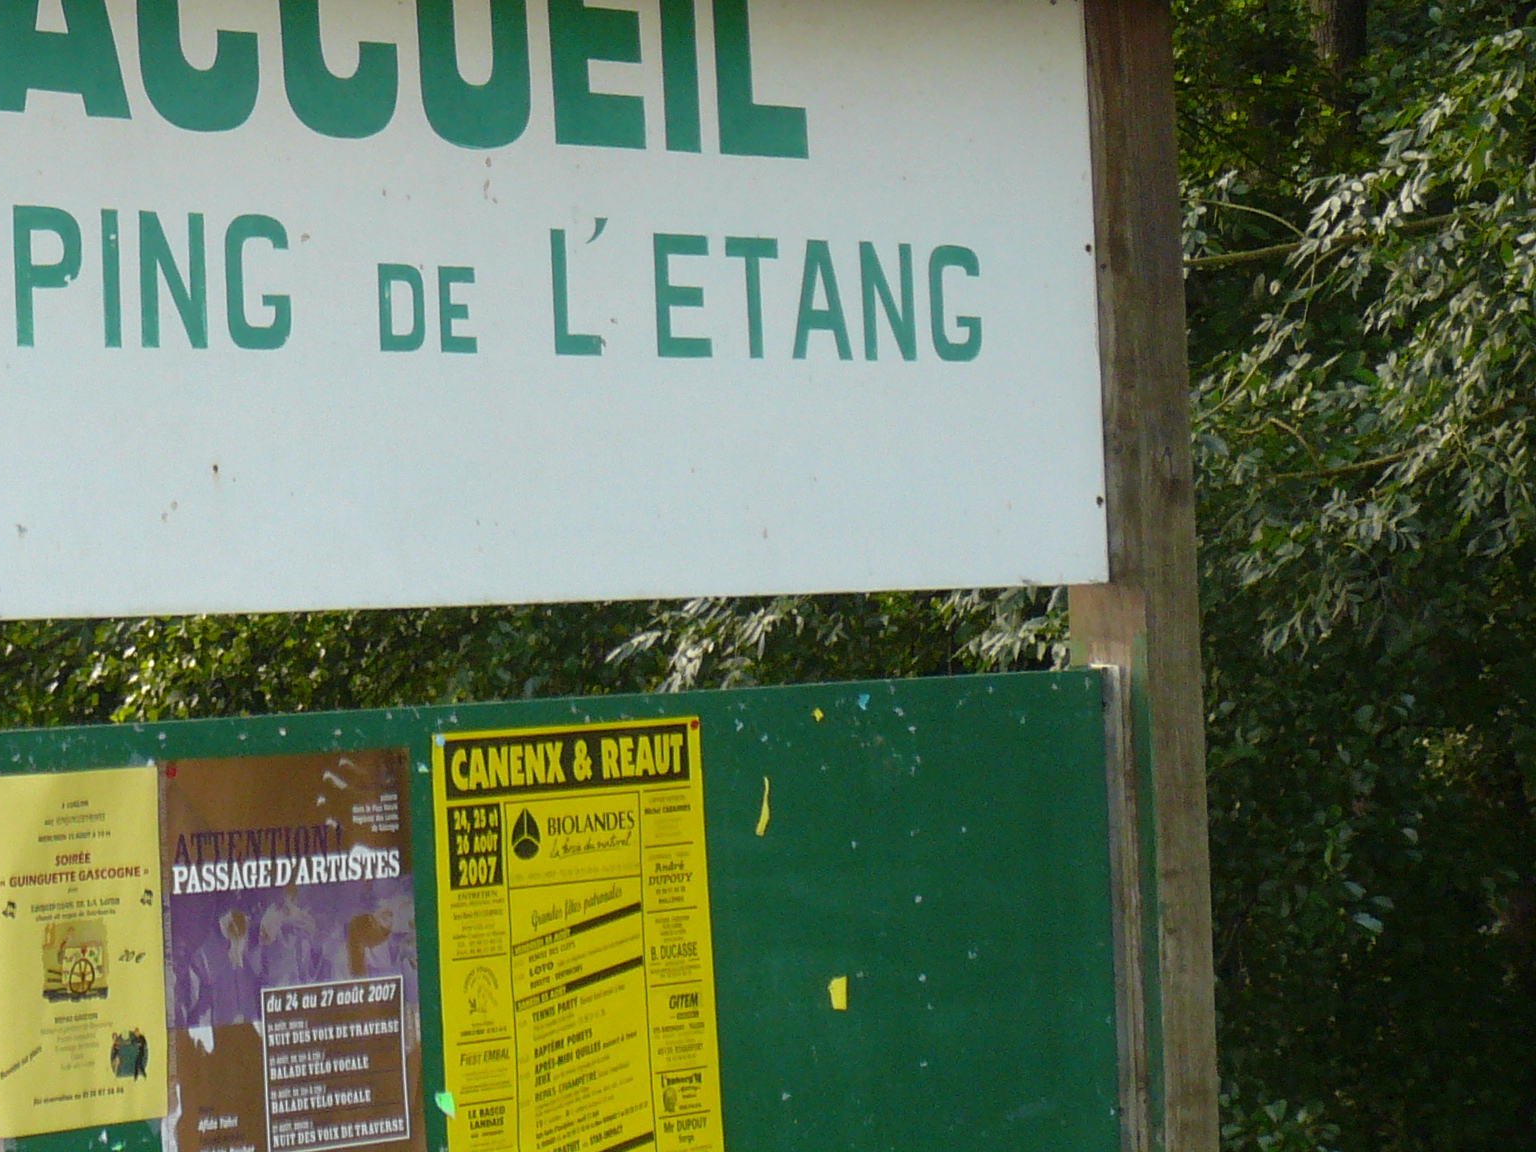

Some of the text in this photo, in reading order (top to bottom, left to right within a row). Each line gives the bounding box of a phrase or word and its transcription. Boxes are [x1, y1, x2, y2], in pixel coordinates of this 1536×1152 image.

[378, 263, 478, 355] DE
[451, 732, 683, 791] CANENX & REAUT
[547, 810, 635, 837] BIOLANDES
[54, 850, 91, 867] SOIRÉE
[655, 860, 684, 874] André
[9, 869, 77, 888] GUINGUETTE
[78, 865, 141, 882] GASCOGNE
[172, 849, 401, 895] PASSAGE D'ARTISTES
[458, 855, 497, 886] 2007
[648, 871, 693, 886] DUPOUY
[660, 941, 698, 960] DUCASSE
[529, 961, 554, 977] LOTO
[267, 994, 282, 1012] du
[302, 995, 317, 1009] au
[320, 989, 335, 1007] 27
[337, 985, 365, 1006] août
[368, 984, 396, 1002] 2007
[669, 992, 698, 1011] GITEM
[268, 1032, 290, 1047] NUIT
[292, 1029, 311, 1044] DES
[336, 1025, 348, 1039] DE
[349, 1019, 400, 1037] TRAVERSE
[270, 1064, 307, 1081] BALADE
[271, 1096, 309, 1115] BALADE
[273, 1133, 296, 1148] NUIT
[298, 1130, 316, 1145] DES
[317, 1127, 339, 1142] VOIX
[341, 1124, 353, 1139] DE
[354, 1118, 405, 1137] TRAVERSE
